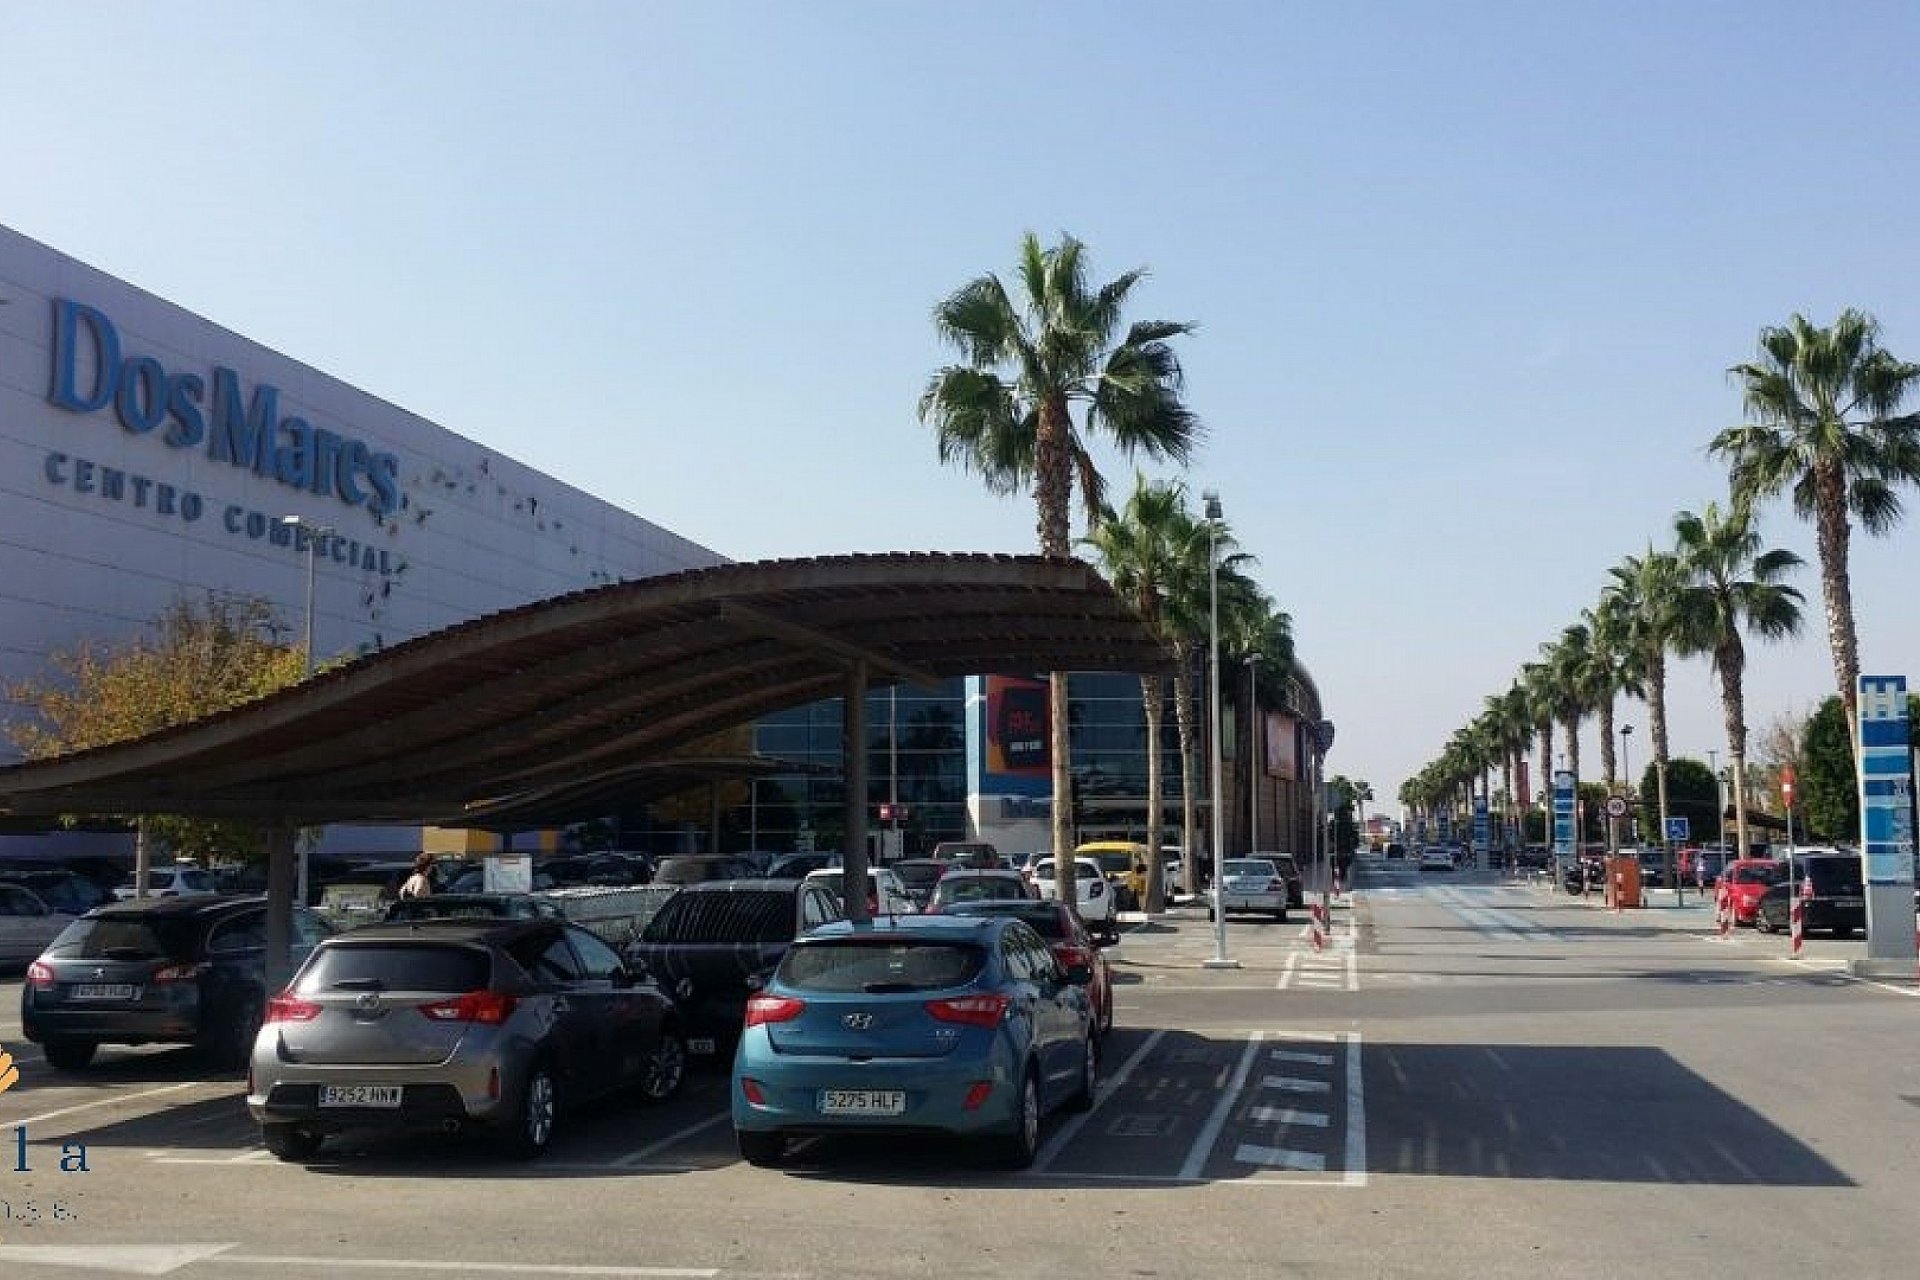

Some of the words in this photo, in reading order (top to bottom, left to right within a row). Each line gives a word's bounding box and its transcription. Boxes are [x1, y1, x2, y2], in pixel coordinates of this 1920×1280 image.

[45, 452, 203, 522] CENTRO
[223, 504, 393, 576] COMERCIAL
[827, 1092, 866, 1108] 5275
[872, 1092, 902, 1110] HLF
